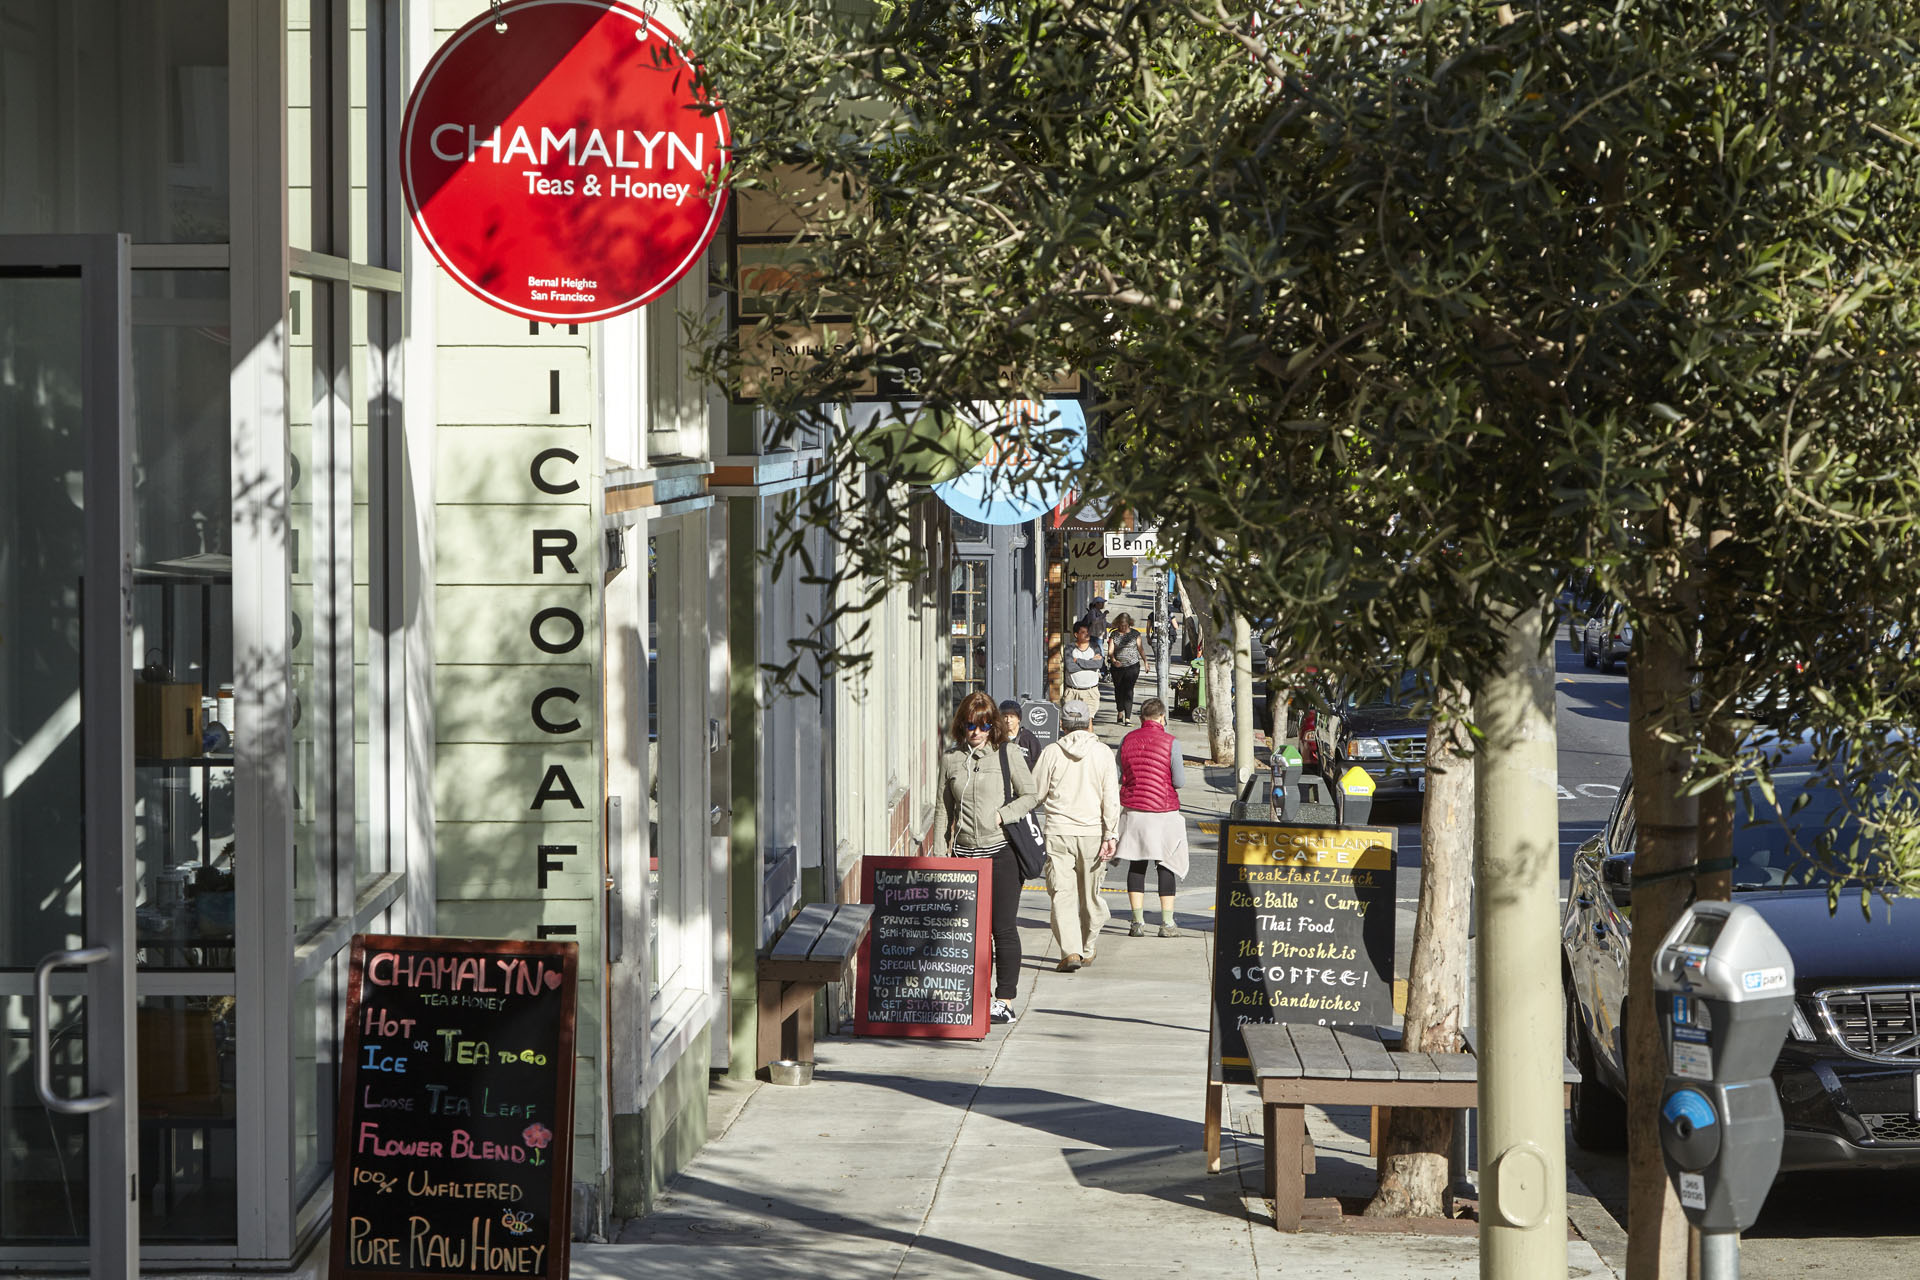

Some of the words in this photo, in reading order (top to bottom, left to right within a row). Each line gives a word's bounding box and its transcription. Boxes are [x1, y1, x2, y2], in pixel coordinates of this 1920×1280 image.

[430, 123, 704, 171] CHAMALYN
[523, 171, 574, 196] Teas
[583, 175, 602, 197] &
[610, 175, 690, 206] Honey
[528, 276, 559, 288] Bernal
[561, 277, 597, 290] Heights
[531, 290, 548, 301] San
[551, 291, 595, 302] Francisco
[1234, 831, 1269, 847] 331
[1274, 831, 1385, 850] CORTLAND
[1238, 867, 1321, 884] Breakfast
[1330, 869, 1374, 885] Lunch
[885, 887, 929, 905] PILATES
[1229, 891, 1262, 908] Rice
[1265, 890, 1298, 908] Balls
[1325, 893, 1372, 917] Curry
[881, 916, 920, 926] PRIVATE
[923, 916, 969, 928] SESSIONS
[1256, 914, 1292, 932] Thai
[1298, 916, 1335, 934] Food
[882, 945, 916, 955] GROUP
[923, 946, 969, 959] CLASSES
[1239, 940, 1264, 958] Hot
[1271, 942, 1357, 960] Piroshkis
[368, 953, 545, 995] CHAMALYN
[880, 959, 917, 970] SPECIAL
[918, 959, 974, 975] WORKSHOPS
[1247, 966, 1369, 988] COFFEE!
[873, 975, 902, 986] VISIT
[905, 976, 919, 987] US
[420, 994, 450, 1007] TEA
[461, 996, 507, 1011] HONEY
[873, 986, 889, 997] TO
[895, 986, 928, 999] LEARN
[932, 989, 963, 1001] MORE
[1230, 988, 1263, 1006] Deli
[1269, 990, 1361, 1012] Sandwiches
[881, 999, 902, 1010] GET
[906, 1000, 965, 1012] STARTED
[413, 1040, 429, 1052] OR
[436, 1029, 490, 1066] TEA
[361, 1045, 408, 1073] ICE
[363, 1084, 414, 1111] LOOSE
[425, 1084, 471, 1117] TEA
[484, 1087, 537, 1119] LEAF
[358, 1121, 443, 1157] FLOWER
[451, 1129, 526, 1163] BLEND
[353, 1167, 398, 1195] 100%
[350, 1216, 401, 1266] PURE
[409, 1216, 465, 1270] RAW
[471, 1216, 546, 1274] HONEY
